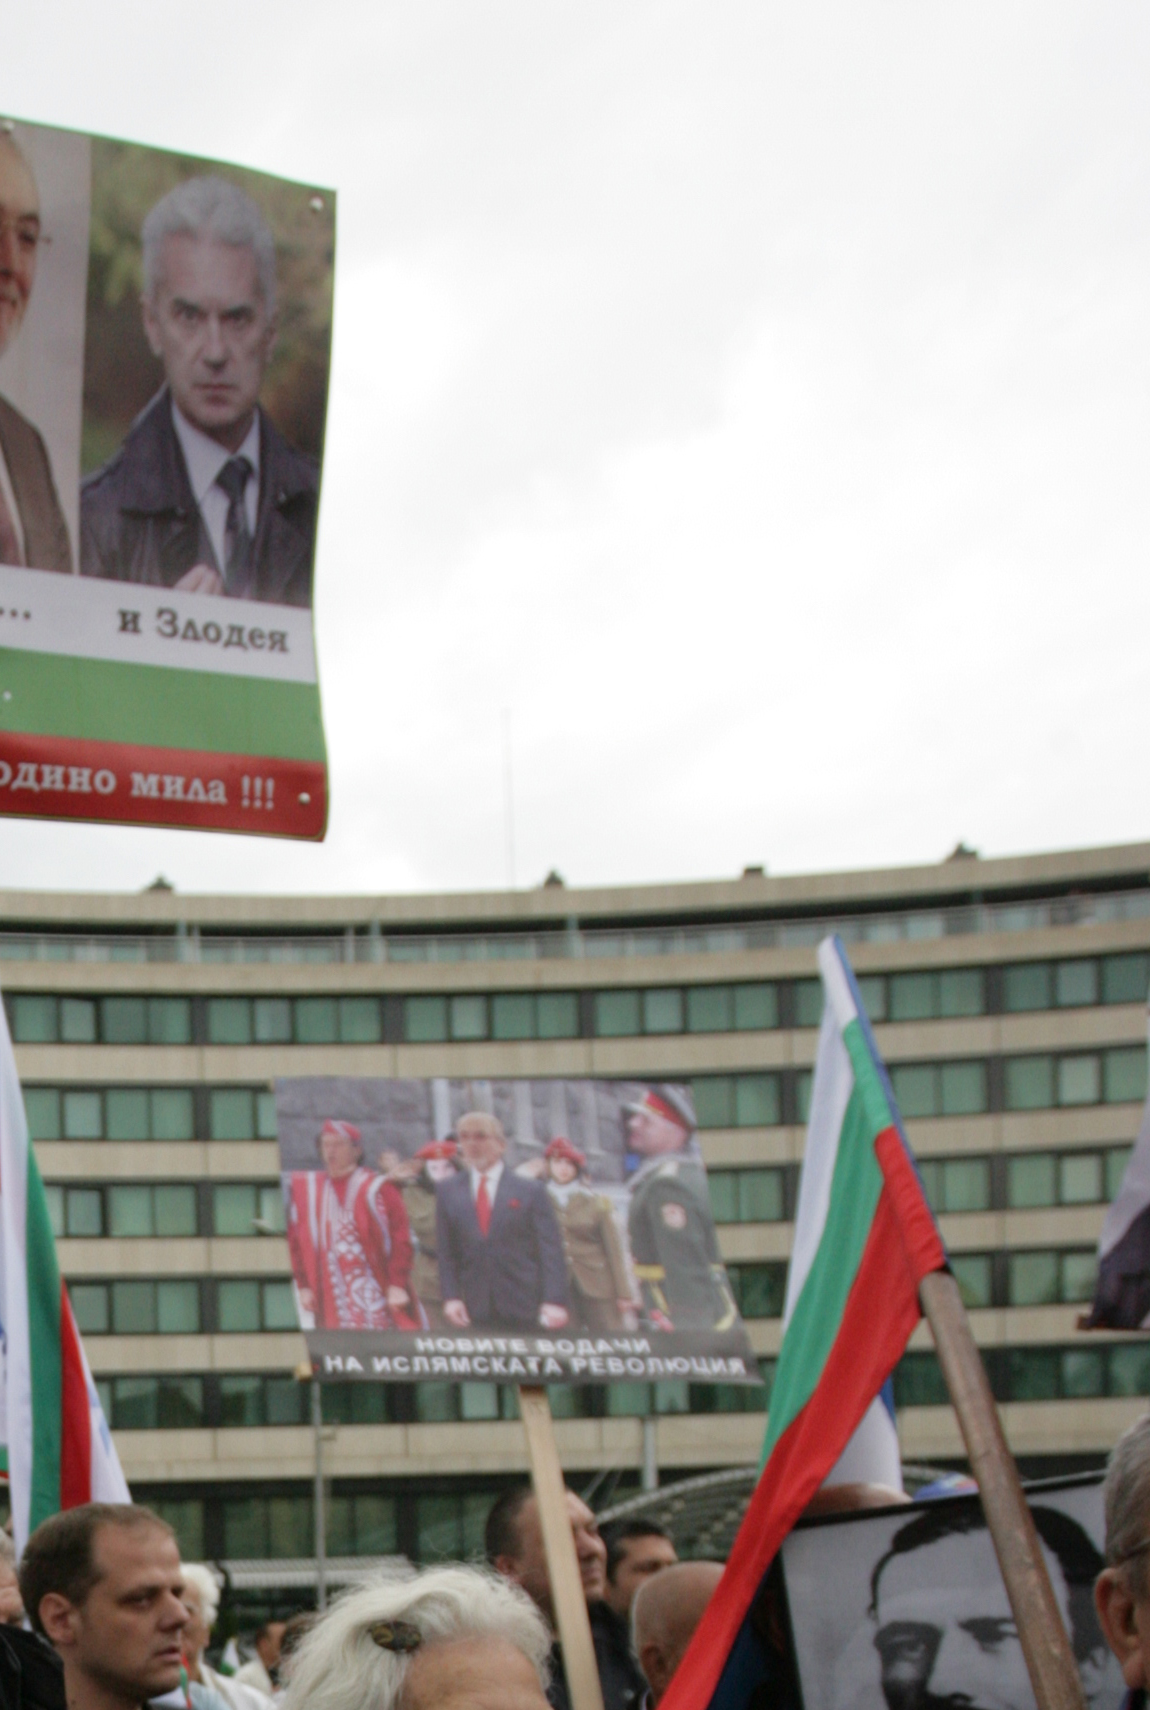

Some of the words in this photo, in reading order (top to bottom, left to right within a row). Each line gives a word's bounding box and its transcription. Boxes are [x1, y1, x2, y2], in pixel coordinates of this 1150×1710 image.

[118, 608, 142, 634] и
[156, 606, 290, 654] Злодея
[130, 771, 228, 806] мила
[415, 1337, 529, 1354] НОВИТЕ
[535, 1338, 651, 1355] ВОДАЧИ
[324, 1355, 364, 1373] НА
[371, 1356, 563, 1375] ИСЛЯМСКАТА
[570, 1356, 746, 1376] РЕВОЛЮЦИЯ
